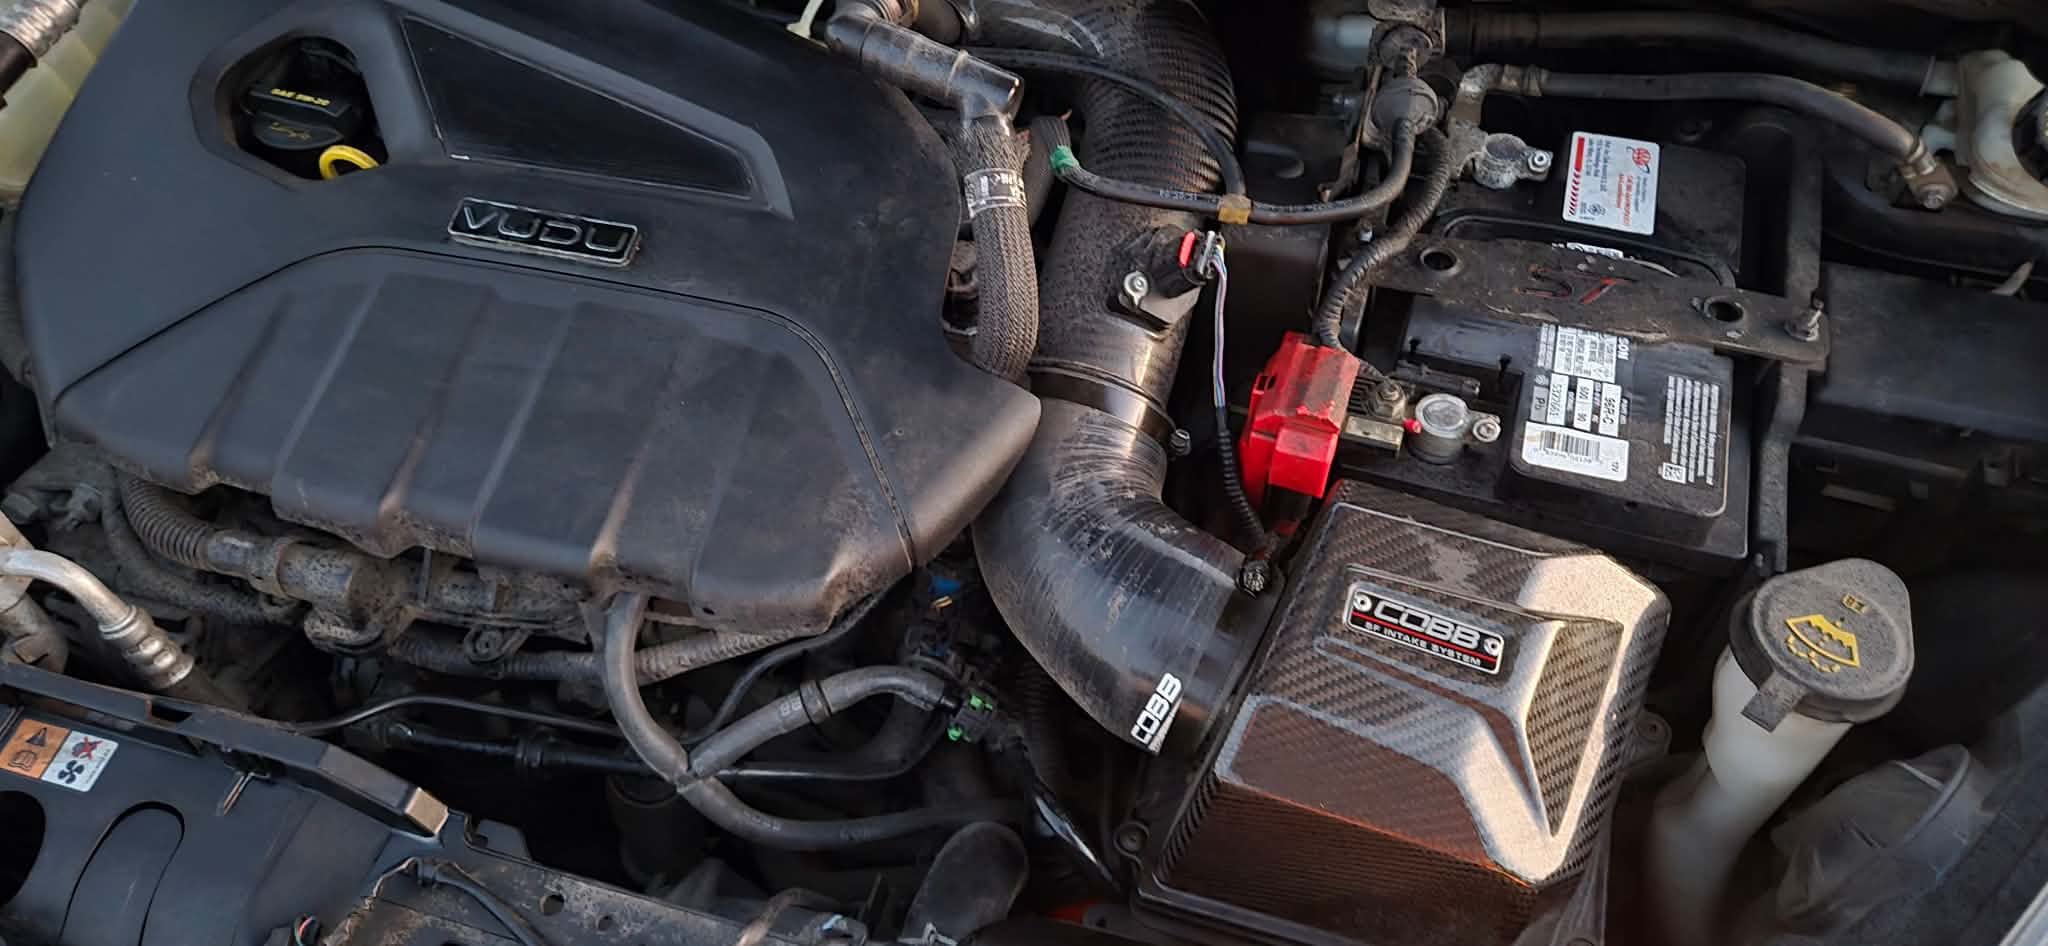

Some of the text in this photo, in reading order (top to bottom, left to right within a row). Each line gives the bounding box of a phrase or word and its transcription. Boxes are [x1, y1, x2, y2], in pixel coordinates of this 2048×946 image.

[463, 206, 629, 253] VUDU
[1364, 621, 1482, 667] SF INTAKE SYSTEM
[1374, 599, 1481, 650] COBB
[1130, 672, 1182, 745] COBB
